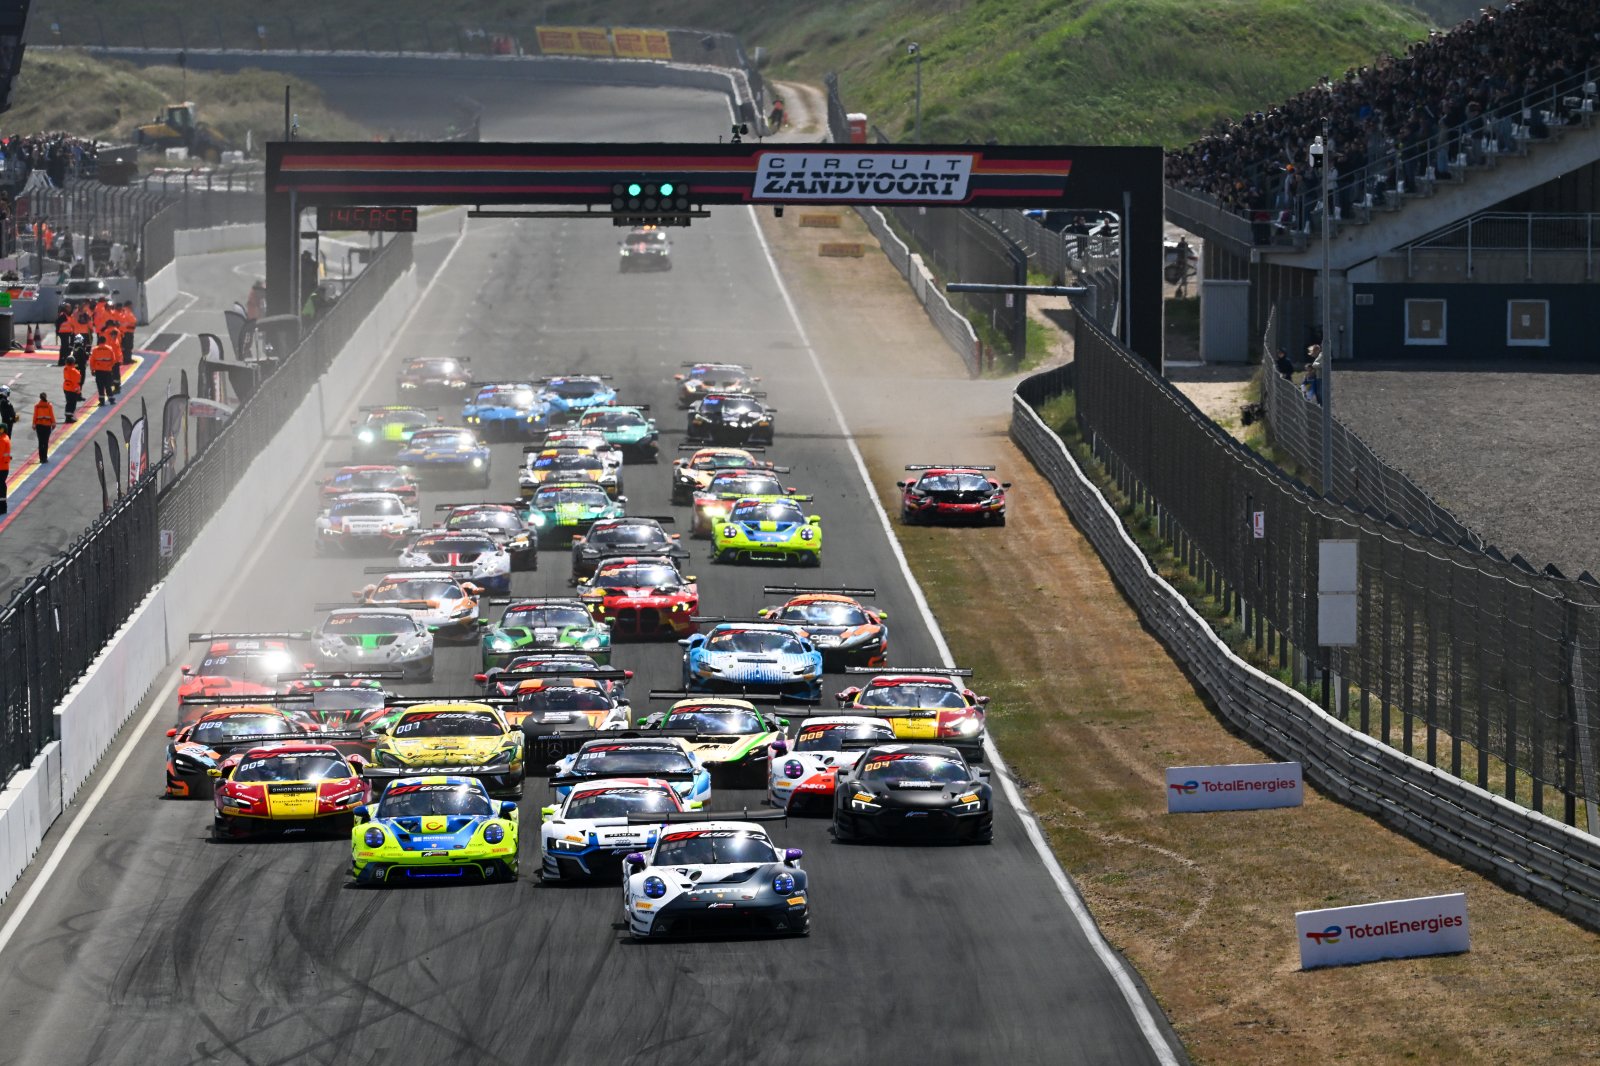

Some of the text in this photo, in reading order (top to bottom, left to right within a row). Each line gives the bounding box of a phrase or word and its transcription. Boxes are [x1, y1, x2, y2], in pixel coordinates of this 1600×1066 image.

[769, 157, 962, 170] CIRCUIT
[763, 171, 961, 196] ZANDVOORT
[1202, 777, 1296, 793] TotalEnergies
[1346, 914, 1463, 940] TotalEnergies
